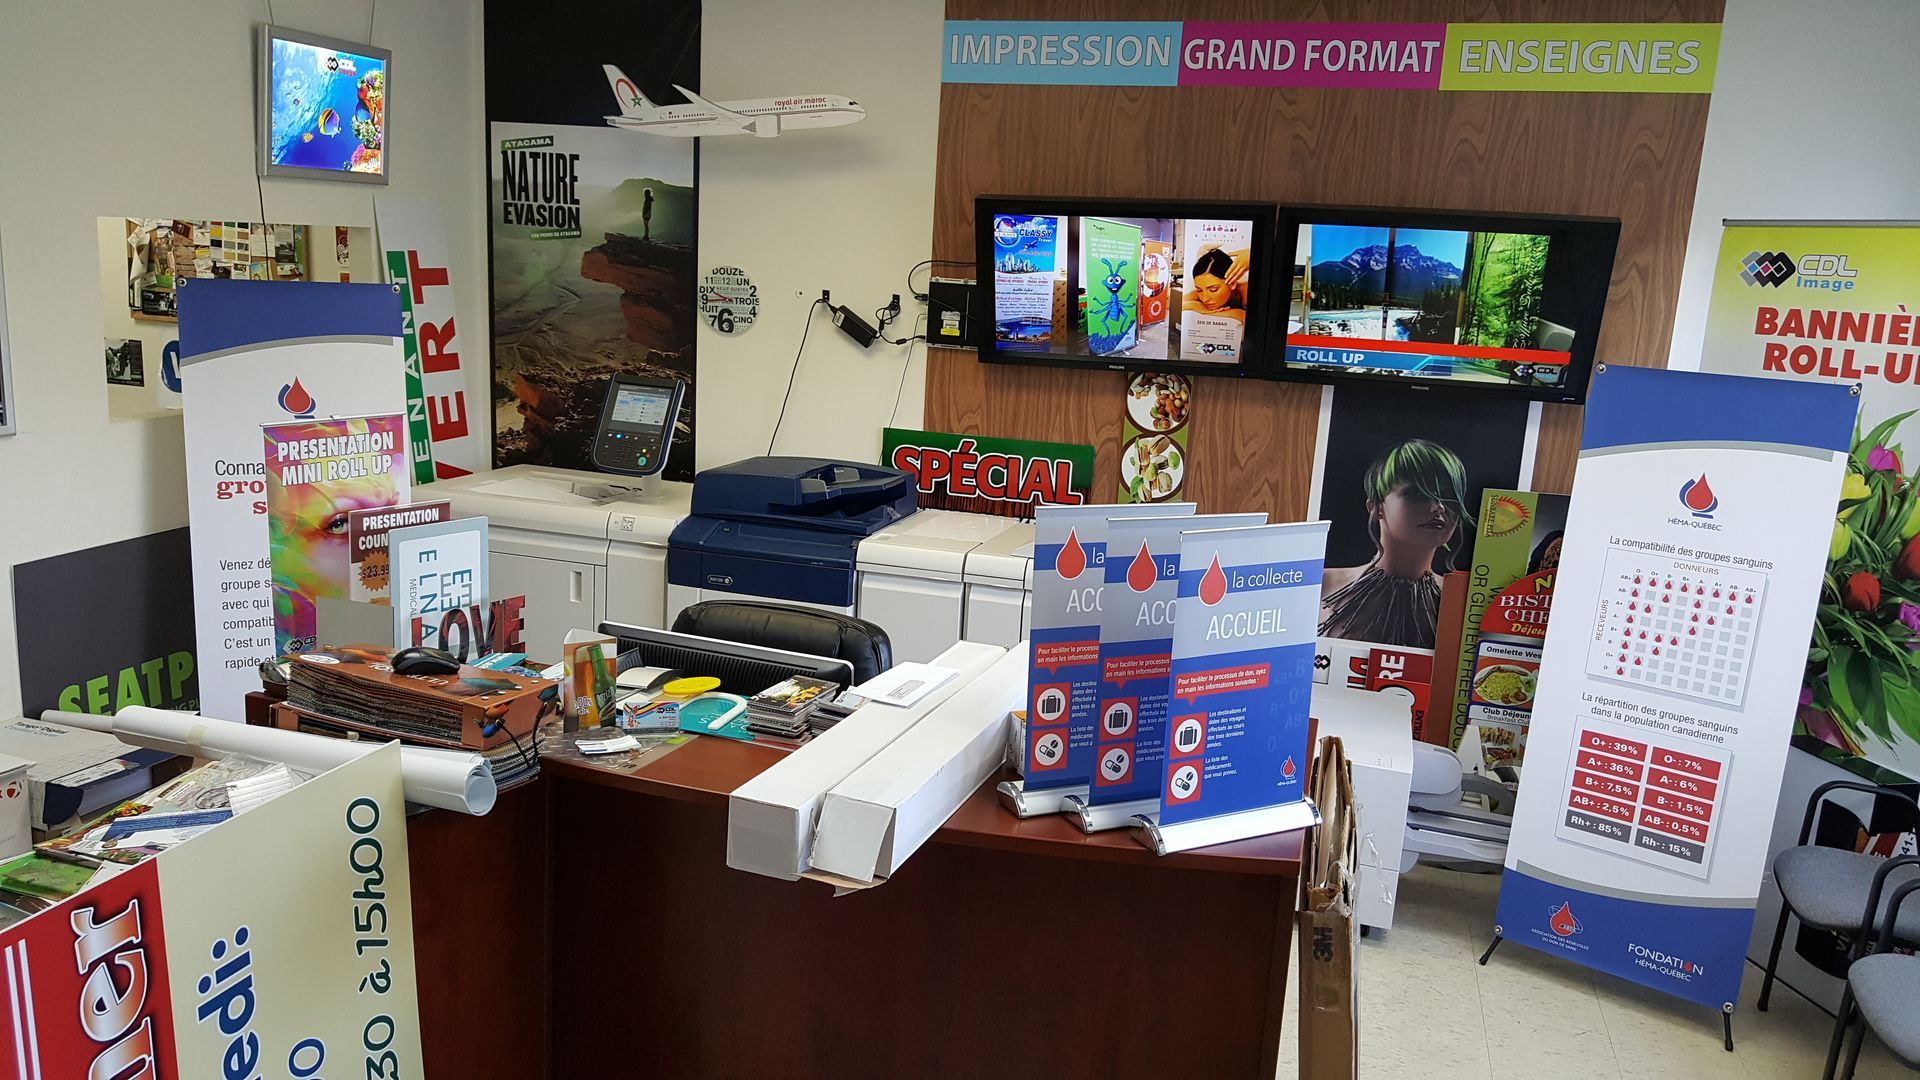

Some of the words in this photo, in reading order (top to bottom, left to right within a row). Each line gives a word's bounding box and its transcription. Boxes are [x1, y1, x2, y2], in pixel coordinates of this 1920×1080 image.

[950, 34, 1171, 67] IMPRESSION
[1184, 39, 1295, 71] GRAND
[1304, 39, 1440, 72] FORMAT
[1459, 39, 1701, 75] ENSEIGNES
[774, 98, 792, 107] royal
[794, 97, 804, 106] air
[804, 96, 826, 105] maroc
[504, 138, 551, 148] ATACAMA
[502, 150, 580, 205] NATURE
[503, 202, 580, 229] EVASION
[1019, 228, 1053, 239] CLASSY
[712, 267, 744, 276] DOUZE
[1797, 254, 1858, 277] CDL
[722, 277, 730, 286] 12
[736, 278, 750, 286] UN
[749, 285, 757, 298] 2
[734, 297, 760, 306] TROIS
[699, 305, 719, 313] HUIT
[749, 306, 758, 318] 4
[709, 315, 718, 327] 7
[718, 308, 734, 333] 6
[1296, 350, 1337, 364] ROLL
[1342, 352, 1365, 364] UP
[1762, 342, 1920, 386] ROLL-U
[277, 431, 394, 462] PRESENTATION
[215, 460, 266, 476] Conna
[282, 464, 322, 487] MINI
[328, 458, 367, 482] ROLL
[371, 453, 393, 475] UP
[892, 439, 1083, 505] SPÉCIAL
[216, 480, 266, 500] gro
[252, 501, 267, 514] s
[362, 507, 440, 531] PRESENTATION
[1668, 517, 1722, 532] HÉMA-QUÉBEC
[358, 533, 389, 550] COUN
[1092, 546, 1104, 564] la
[1610, 536, 1620, 545] La
[1622, 538, 1676, 554] compatibilité
[1677, 545, 1693, 556] des
[1695, 550, 1730, 563] groupes
[1733, 555, 1773, 570] sanguins
[220, 560, 254, 571] Venez
[257, 557, 271, 569] dé
[1163, 559, 1175, 576] la
[1673, 562, 1720, 576] DONNEURS
[221, 579, 260, 593] groupe
[1232, 570, 1244, 588] la
[1248, 568, 1303, 587] collecte
[1473, 565, 1489, 588] OR
[222, 600, 249, 610] avec
[252, 597, 270, 610] qui
[223, 616, 274, 630] compatib
[1206, 608, 1286, 640] ACCUEIL
[1464, 596, 1485, 654] GLUTEN
[1595, 599, 1609, 641] RECEVEURS
[224, 637, 253, 650] C'est
[256, 637, 271, 647] un
[1486, 646, 1523, 657] Omelette
[225, 656, 260, 670] rapide
[58, 650, 194, 716] SEATP
[1205, 681, 1234, 690] informations
[1235, 678, 1257, 687] suivantes
[1214, 672, 1238, 682] processus
[1458, 658, 1475, 698] FREE
[1483, 707, 1500, 716] Club
[1503, 709, 1532, 720] Déjeun
[1487, 714, 1516, 723] Breakfast
[1582, 692, 1592, 701] La
[1595, 695, 1638, 712] répartition
[1641, 705, 1656, 716] des
[1658, 709, 1695, 724] groupes
[1697, 719, 1739, 734] sanguins
[1591, 706, 1612, 718] dans
[1614, 711, 1622, 720] la
[1624, 714, 1670, 731] population
[1672, 725, 1724, 743] canadienne
[1592, 737, 1606, 746] O+
[1613, 742, 1637, 755] 39%
[1587, 757, 1602, 766] A+
[1610, 762, 1634, 775] 36%
[1664, 754, 1676, 763] O-
[1684, 760, 1701, 771] 7%
[1585, 777, 1599, 786] B+
[1607, 782, 1632, 796] 7,5%
[1660, 775, 1672, 784] A-
[1679, 780, 1698, 791] 6%
[1573, 795, 1594, 806] AB+
[1602, 802, 1629, 817] 2,5%
[1657, 796, 1668, 804] B-
[1676, 801, 1704, 815] 1,5%
[1571, 815, 1591, 827] Rh+
[1598, 823, 1622, 836] 85%
[1644, 814, 1664, 825] AB-
[1671, 821, 1700, 836] 0,5%
[1642, 835, 1660, 847] Rh-
[1668, 844, 1691, 856] 15%
[346, 797, 390, 957] 15h00
[1312, 926, 1334, 962] 3M
[358, 958, 392, 994] à
[1635, 958, 1692, 982] HÉMA-QUÉBEC
[196, 925, 261, 1080] edi:
[288, 1036, 326, 1080] 0
